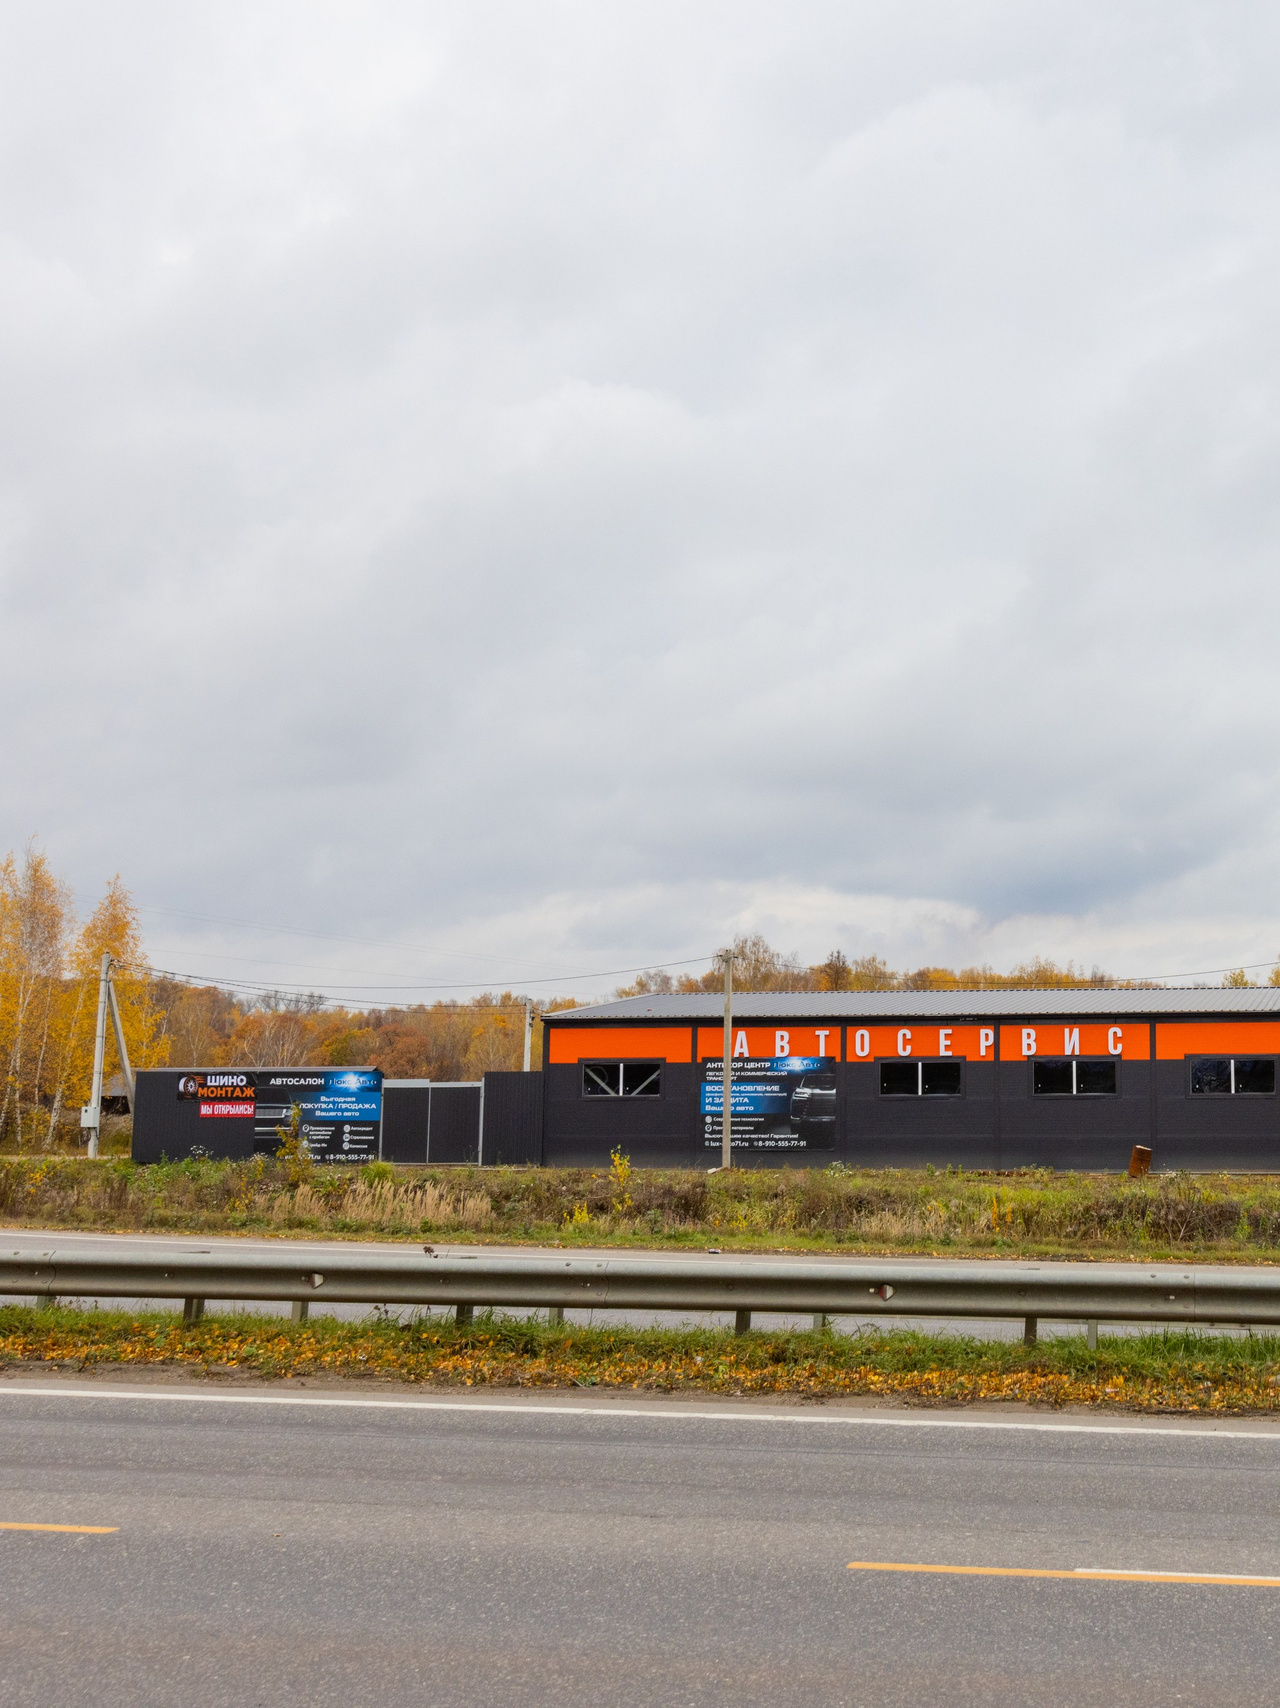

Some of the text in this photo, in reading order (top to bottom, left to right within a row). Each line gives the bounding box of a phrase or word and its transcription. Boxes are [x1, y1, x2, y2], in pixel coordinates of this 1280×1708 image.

[734, 1027, 1122, 1057] АВТОСЕРВИС
[207, 1075, 247, 1086] ШИНО
[197, 1087, 255, 1098] МОНТАЖ
[201, 1104, 254, 1115] МЫ ОТКРЫЛИСЬ!
